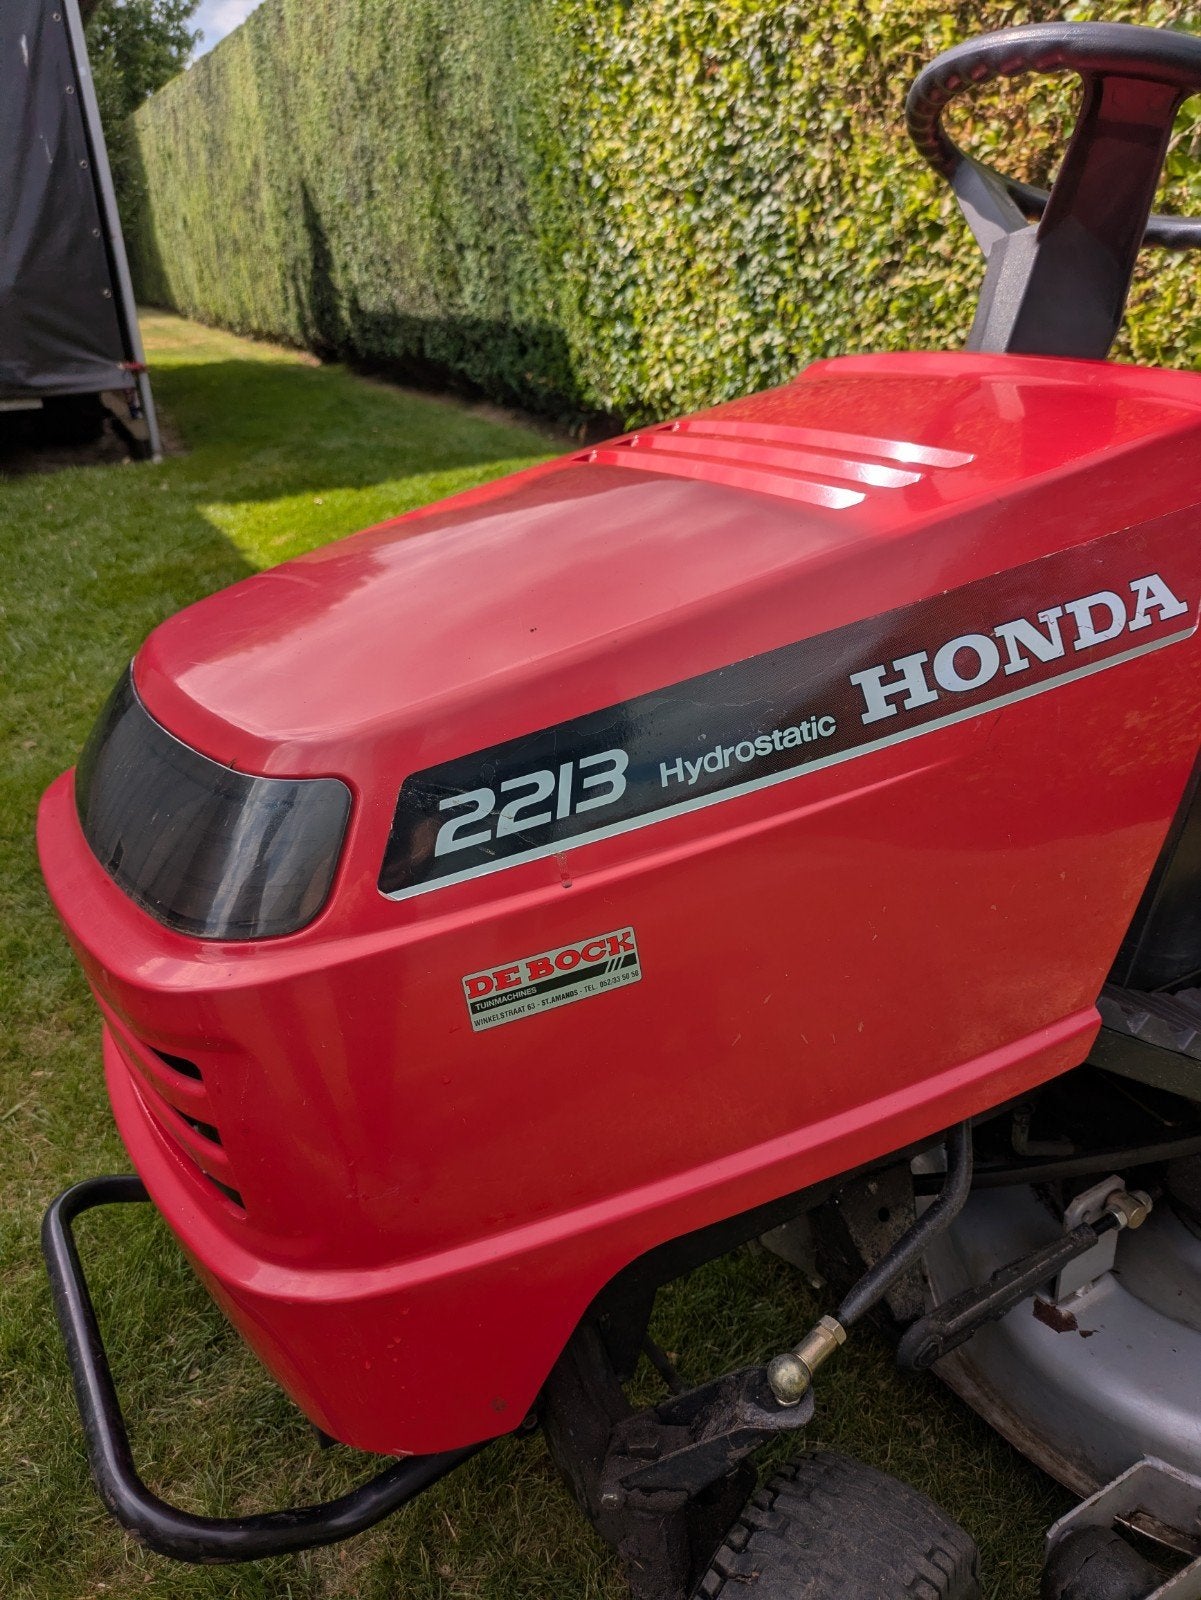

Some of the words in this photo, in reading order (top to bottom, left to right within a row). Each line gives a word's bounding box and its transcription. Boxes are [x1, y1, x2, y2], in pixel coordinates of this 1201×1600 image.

[850, 573, 1189, 725] HONDA
[434, 748, 630, 857] 2213
[659, 714, 837, 787] Hydrostatic
[465, 965, 522, 999] DE
[526, 931, 635, 982] BOCK
[475, 986, 537, 1011] TUINMACHINES
[474, 1005, 526, 1027] WINKELSTRAAT
[526, 1002, 536, 1011] 63
